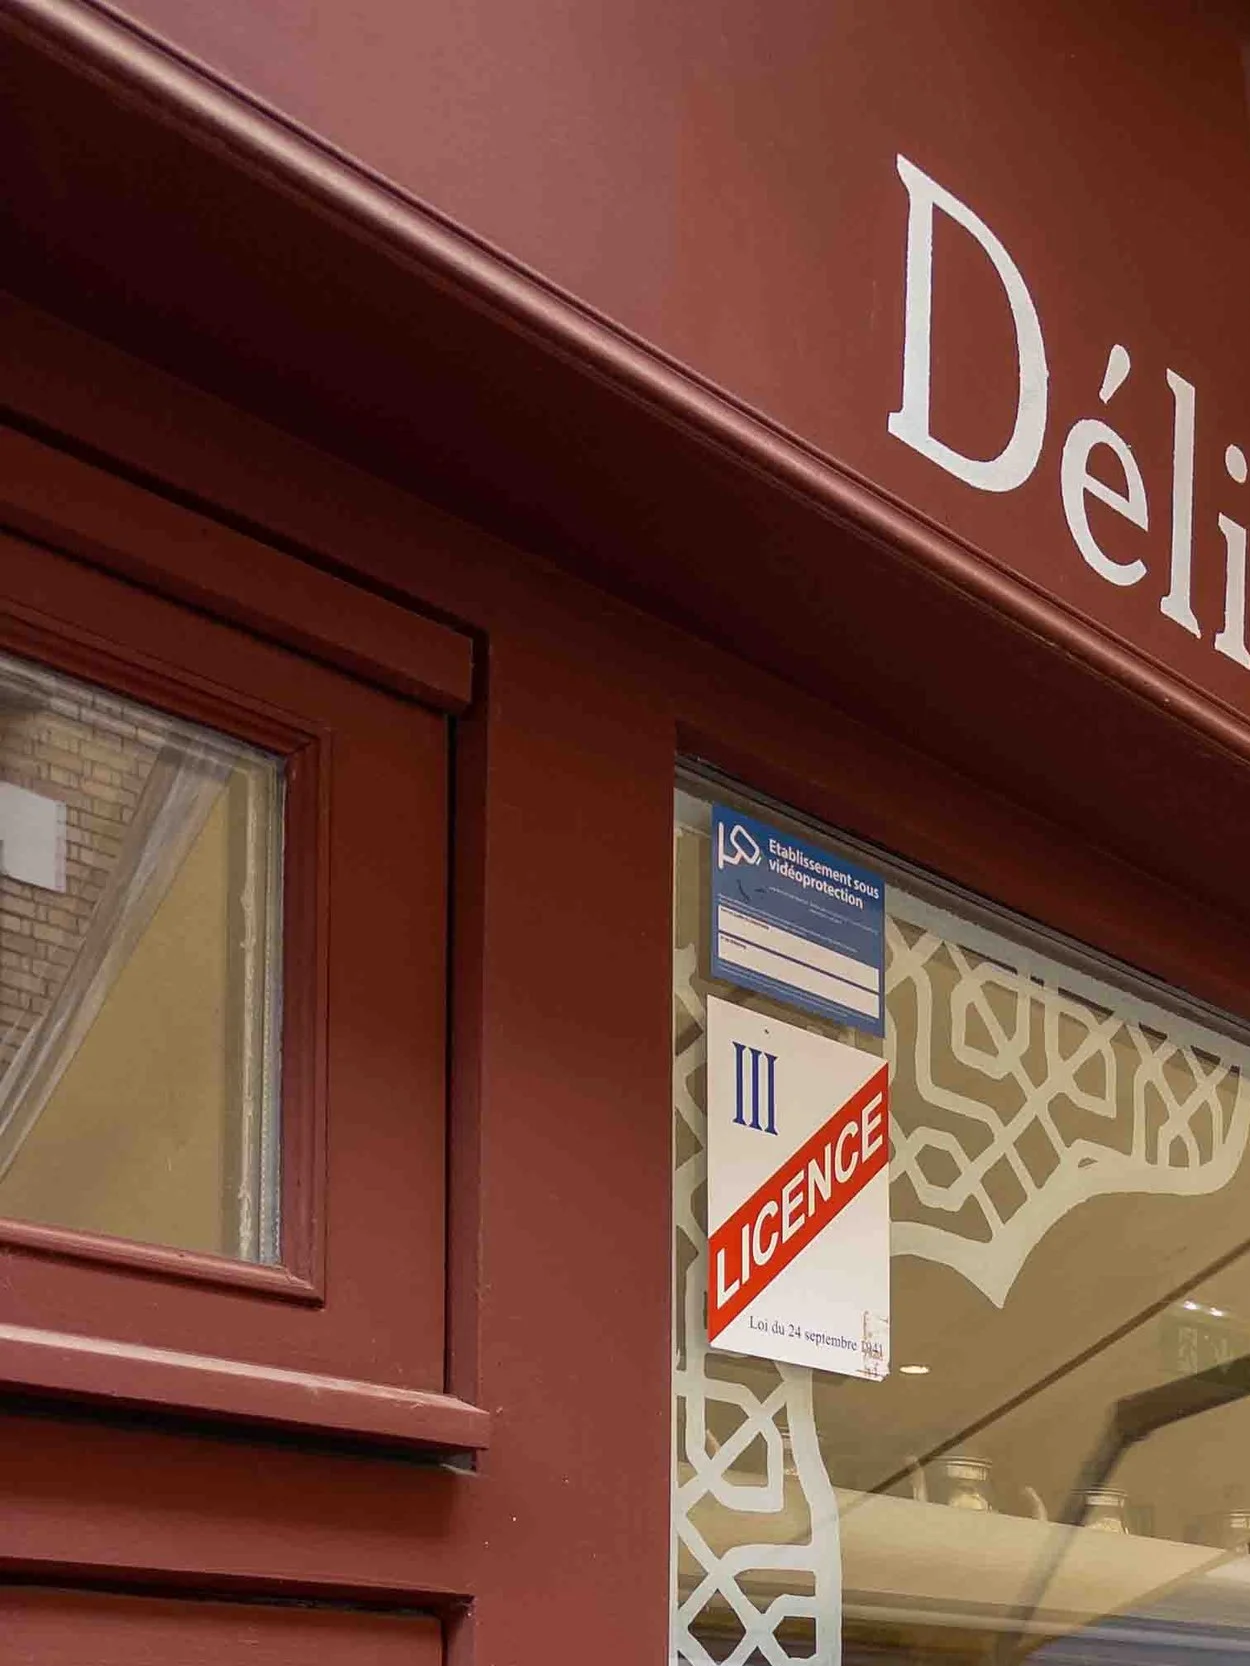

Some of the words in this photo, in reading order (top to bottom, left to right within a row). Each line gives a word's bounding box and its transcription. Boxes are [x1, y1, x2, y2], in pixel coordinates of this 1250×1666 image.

[768, 838, 852, 888] Etablissement
[853, 880, 881, 900] sous
[768, 858, 865, 912] vidéoprotection
[731, 1040, 779, 1137] III
[716, 1090, 884, 1310] LICENCE
[749, 1315, 769, 1332] Loi
[771, 1320, 785, 1336] du
[788, 1323, 801, 1339] 24
[804, 1331, 858, 1351] septembre
